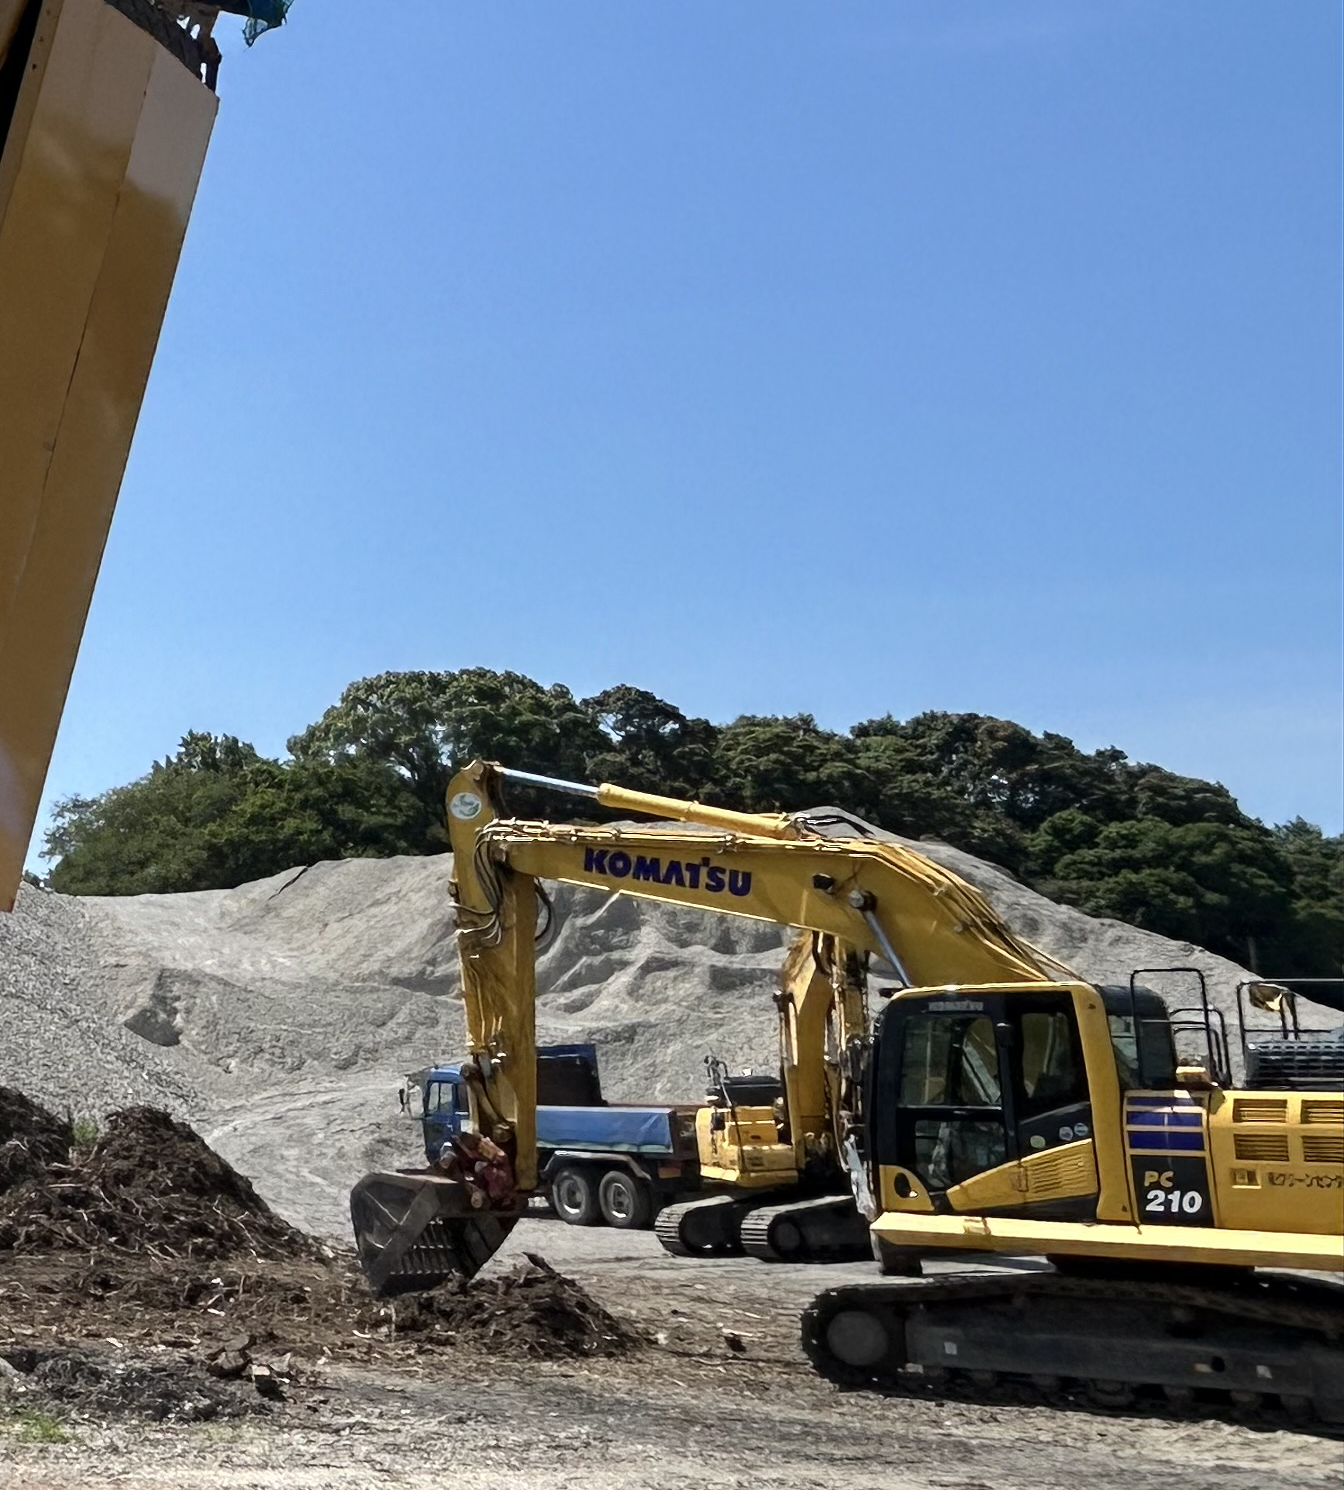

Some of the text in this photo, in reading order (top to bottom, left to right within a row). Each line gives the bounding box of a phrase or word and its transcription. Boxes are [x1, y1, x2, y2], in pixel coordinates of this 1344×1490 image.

[584, 847, 752, 897] KOMATSU
[1144, 1171, 1174, 1188] PC
[1145, 1189, 1203, 1214] 210
